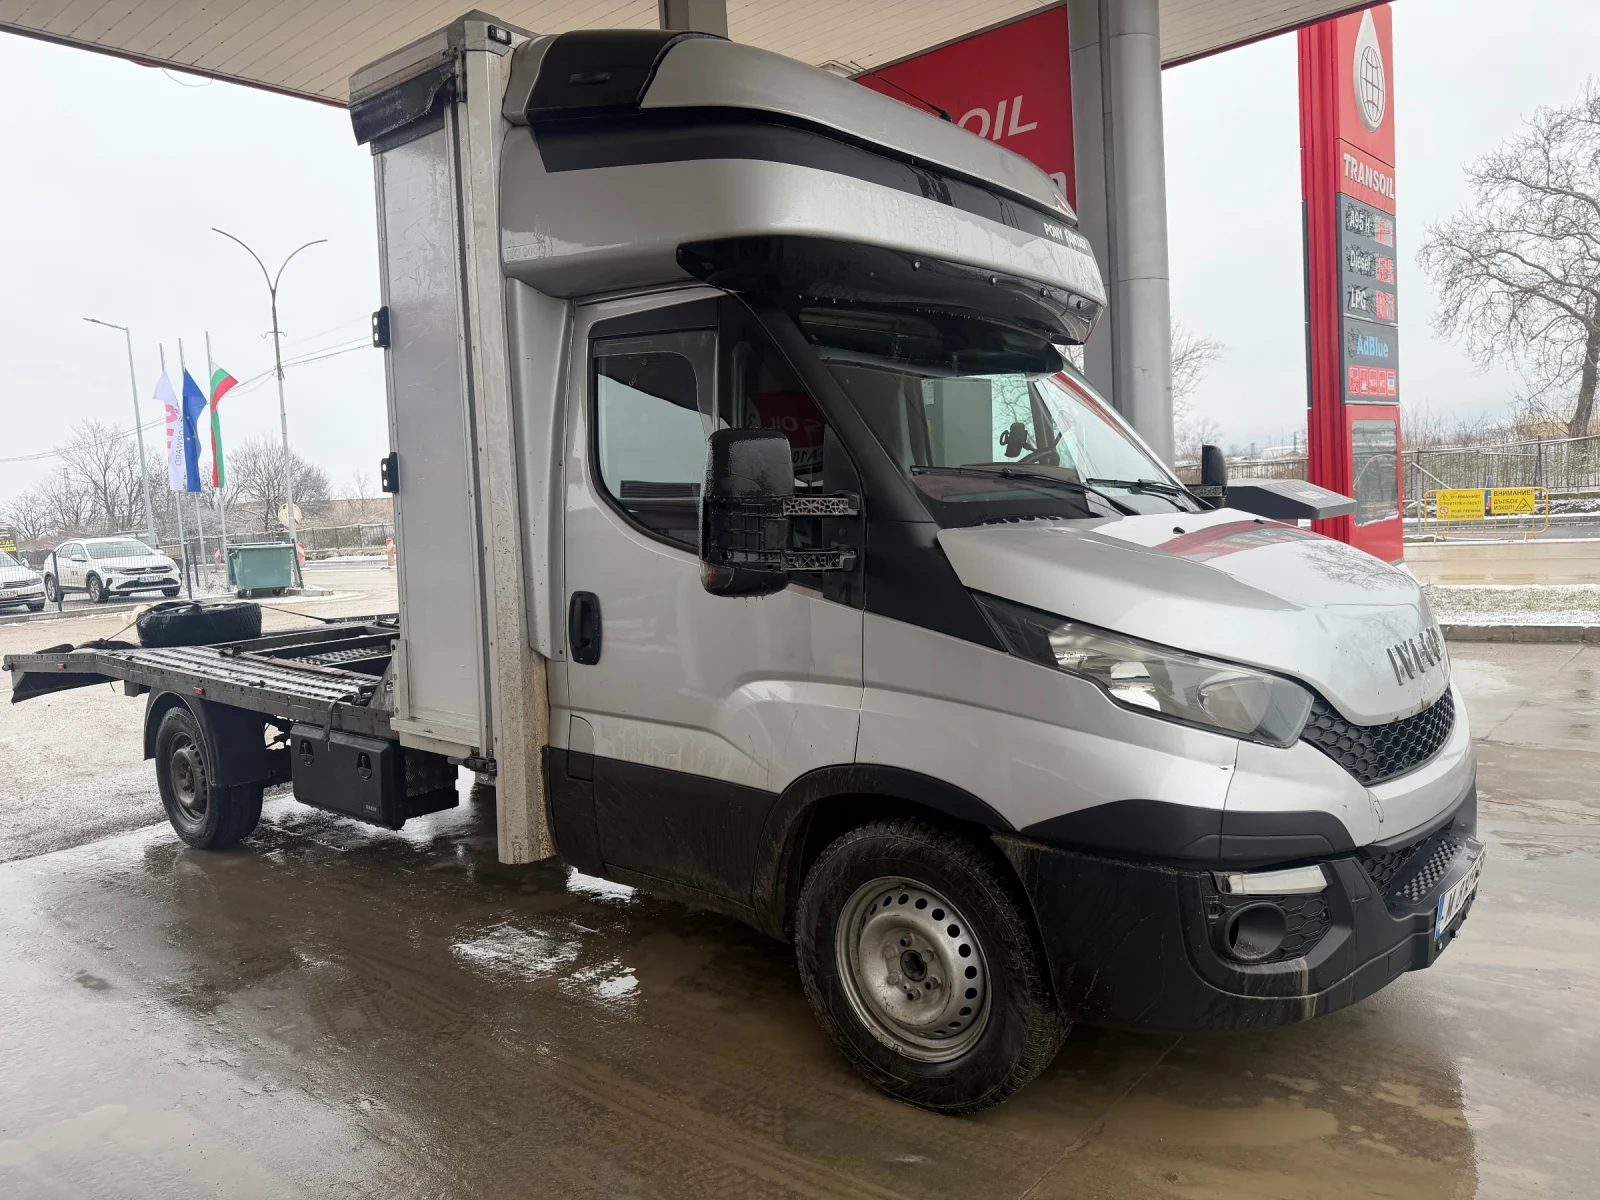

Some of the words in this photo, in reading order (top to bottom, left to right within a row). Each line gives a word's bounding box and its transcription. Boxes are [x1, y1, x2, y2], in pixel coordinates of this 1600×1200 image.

[1343, 152, 1395, 200] TRANSOIL
[1350, 250, 1371, 272] Diesel
[1351, 288, 1367, 311] LPG
[1357, 335, 1389, 358] AdBlue
[1493, 489, 1533, 497] ВНИМАНИЕ!
[1386, 626, 1441, 686] IVECO
